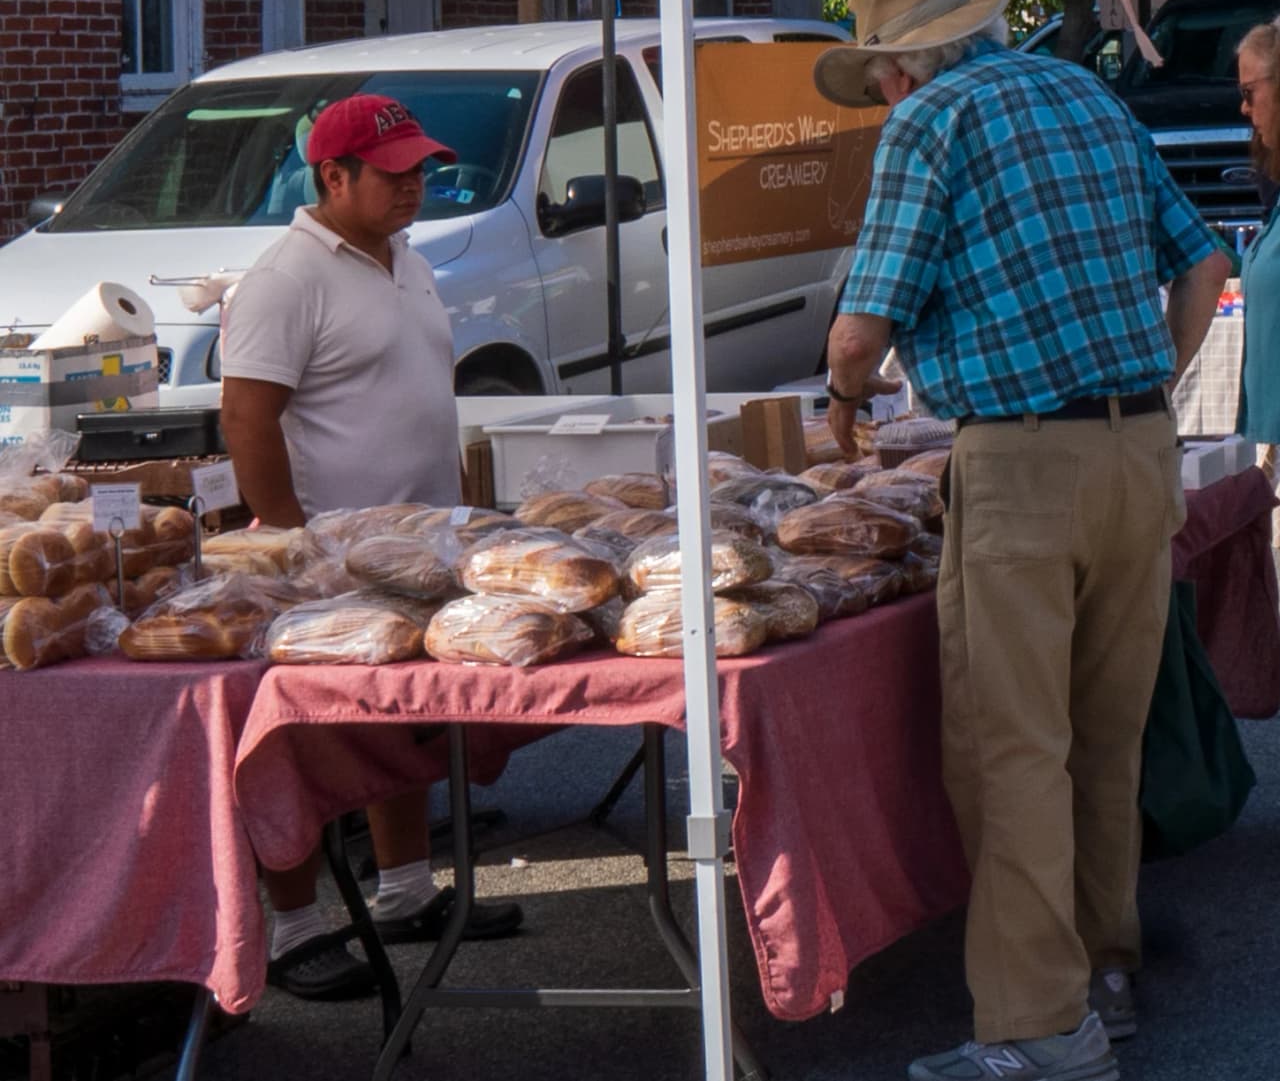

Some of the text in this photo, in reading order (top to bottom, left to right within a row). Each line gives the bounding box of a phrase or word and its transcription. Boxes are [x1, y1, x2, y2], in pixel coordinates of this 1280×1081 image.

[708, 115, 836, 152] SHEPHERD'S WHEY
[760, 161, 827, 190] CREAMERY
